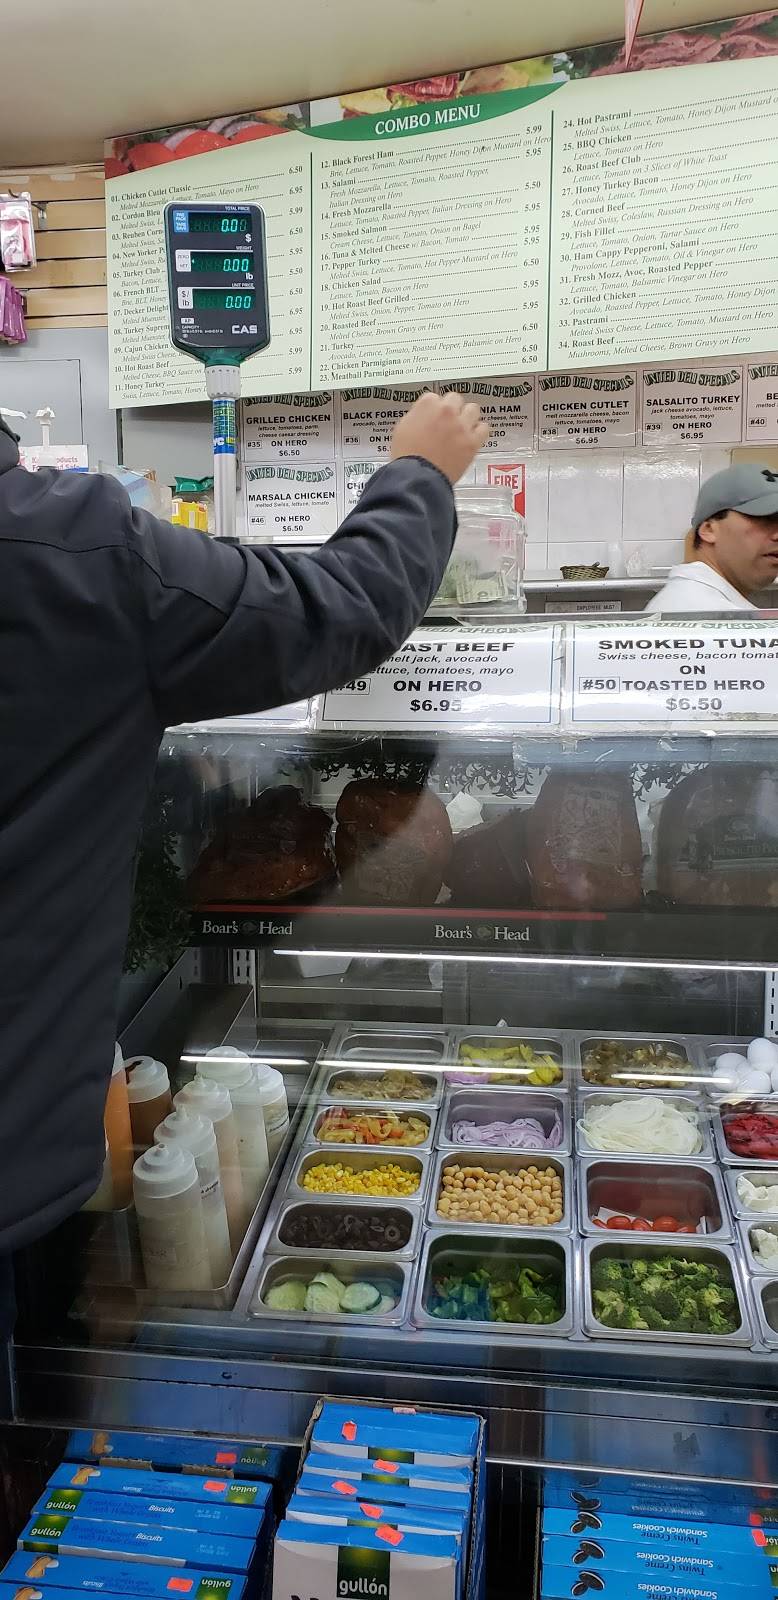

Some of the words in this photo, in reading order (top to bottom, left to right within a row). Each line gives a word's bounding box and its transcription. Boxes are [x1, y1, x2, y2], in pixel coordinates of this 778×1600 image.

[375, 113, 430, 135] COMBO
[435, 104, 481, 124] MENU
[563, 120, 574, 128] 24.
[577, 117, 592, 126] Hot
[595, 110, 631, 123] Pastrami
[332, 158, 351, 166] Black
[353, 155, 375, 163] Forest
[377, 151, 394, 159] Ham
[526, 125, 542, 134] 5.99
[563, 143, 575, 151] 25.
[577, 140, 596, 149] BBQ
[599, 133, 631, 145] Chicken
[562, 166, 574, 174] 26.
[576, 162, 599, 172] Roast
[601, 158, 619, 167] Beef
[621, 155, 641, 164] Club
[122, 190, 146, 201] Chicken
[148, 188, 167, 197] Cutlet
[169, 185, 191, 193] Classic
[289, 166, 302, 174] 6.50
[562, 188, 573, 196] 27.
[576, 184, 600, 195] Honey
[604, 179, 630, 190] Turkey
[634, 176, 658, 185] Bacon
[245, 234, 251, 242] $
[561, 232, 572, 241] 29.
[575, 229, 592, 239] Fish
[595, 227, 615, 236] Fillet
[560, 254, 571, 262] 30.
[574, 251, 593, 261] Ham
[596, 248, 621, 260] Cappy
[624, 243, 668, 255] Pepperoni,
[670, 238, 699, 248] Salami
[223, 259, 249, 271] 0.00
[332, 280, 360, 290] Chicken
[362, 277, 381, 285] Salad
[524, 258, 539, 266] 6.50
[560, 276, 571, 284] 31.
[574, 272, 596, 282] Fresh
[598, 270, 622, 280] Mozz,
[624, 268, 645, 277] Avoc,
[648, 263, 680, 273] Roasted
[684, 260, 713, 270] Pepper
[226, 296, 251, 308] 0.00
[559, 297, 570, 306] 32.
[573, 293, 601, 304] Grilled
[604, 291, 636, 300] Chicken
[559, 319, 570, 327] 33.
[573, 316, 608, 325] Pastrami
[232, 325, 257, 333] CAS
[559, 341, 569, 349] 34.
[572, 338, 594, 347] Roast
[597, 337, 615, 345] Beef
[568, 349, 610, 359] Mushrooms,
[614, 346, 638, 354] Melted
[639, 344, 666, 353] Cheese,
[669, 341, 693, 349] Brown
[696, 338, 718, 347] Gravy
[732, 335, 750, 343] Hero
[332, 360, 359, 370] Chicken
[361, 357, 401, 368] Parmigiana
[522, 344, 537, 352] 6.50
[543, 403, 586, 411] CHICKEN
[589, 401, 629, 409] CUTLET
[647, 397, 698, 406] SALSALITO
[701, 395, 740, 403] TURKEY
[289, 414, 330, 422] CHICKEN
[295, 491, 335, 499] CHICKEN
[401, 643, 447, 651] AST
[455, 643, 515, 651] BEEF
[598, 639, 704, 650] SMOKED
[411, 655, 441, 664] jack,
[445, 655, 498, 663] avocado
[598, 652, 636, 660] Swiss
[641, 652, 691, 661] cheese,
[414, 667, 475, 675] tomatoes,
[479, 667, 514, 676] mayo
[680, 665, 706, 675] ON
[394, 681, 421, 691] ON
[428, 681, 482, 692] HERO
[583, 679, 616, 690] #50
[623, 680, 707, 690] TOASTED
[714, 680, 765, 690] HERO
[410, 700, 462, 712] $6.95
[666, 697, 722, 711] $6.50
[202, 920, 238, 934] Boar's
[259, 922, 293, 935] Head
[435, 925, 472, 939] Boar's
[494, 927, 530, 941] Head
[231, 1484, 257, 1493] gullón
[45, 1499, 76, 1512] gullón
[148, 1504, 175, 1514] Biscuits
[30, 1527, 62, 1538] gullón
[633, 1523, 665, 1533] Cookies
[666, 1526, 708, 1537] Sandwich
[136, 1532, 163, 1542] Biscuits
[636, 1552, 670, 1562] Cookies
[672, 1557, 714, 1567] Sandwich
[201, 1578, 232, 1588] gullón
[339, 1578, 387, 1595] gullón
[637, 1584, 672, 1594] Cookies
[674, 1588, 717, 1599] Sandwich
